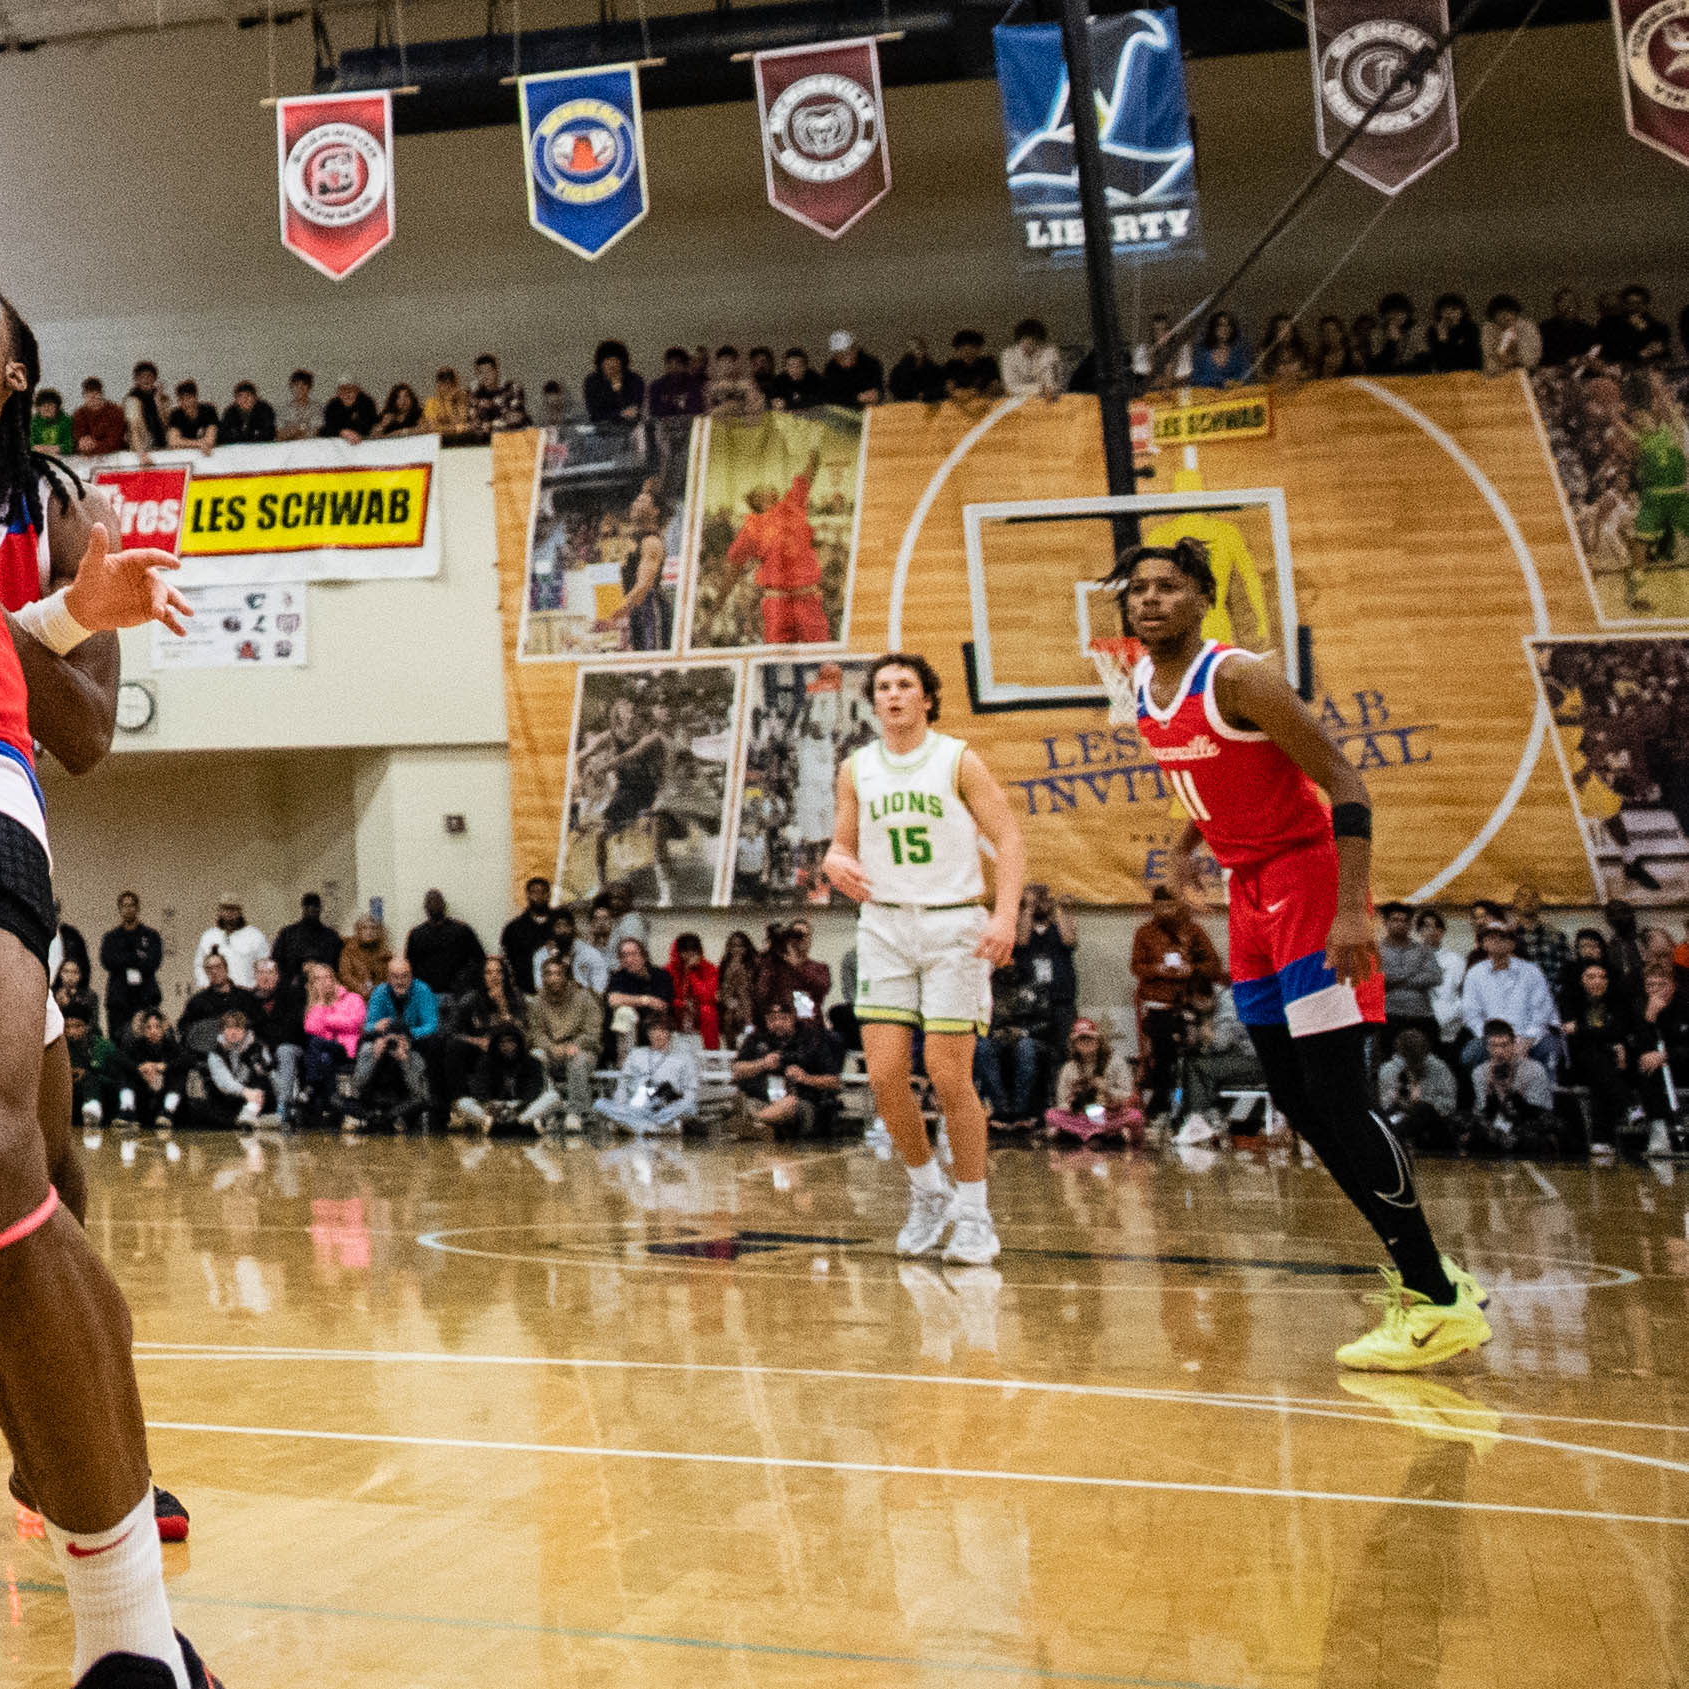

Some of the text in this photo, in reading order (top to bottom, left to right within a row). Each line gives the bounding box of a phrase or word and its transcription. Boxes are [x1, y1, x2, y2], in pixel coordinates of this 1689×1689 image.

[1025, 208, 1192, 248] LIBRTY
[190, 487, 411, 533] LES SCHWAB
[1043, 730, 1142, 771] LES
[869, 790, 944, 822] LIONS
[1169, 768, 1212, 822] 11
[887, 824, 933, 865] 15
